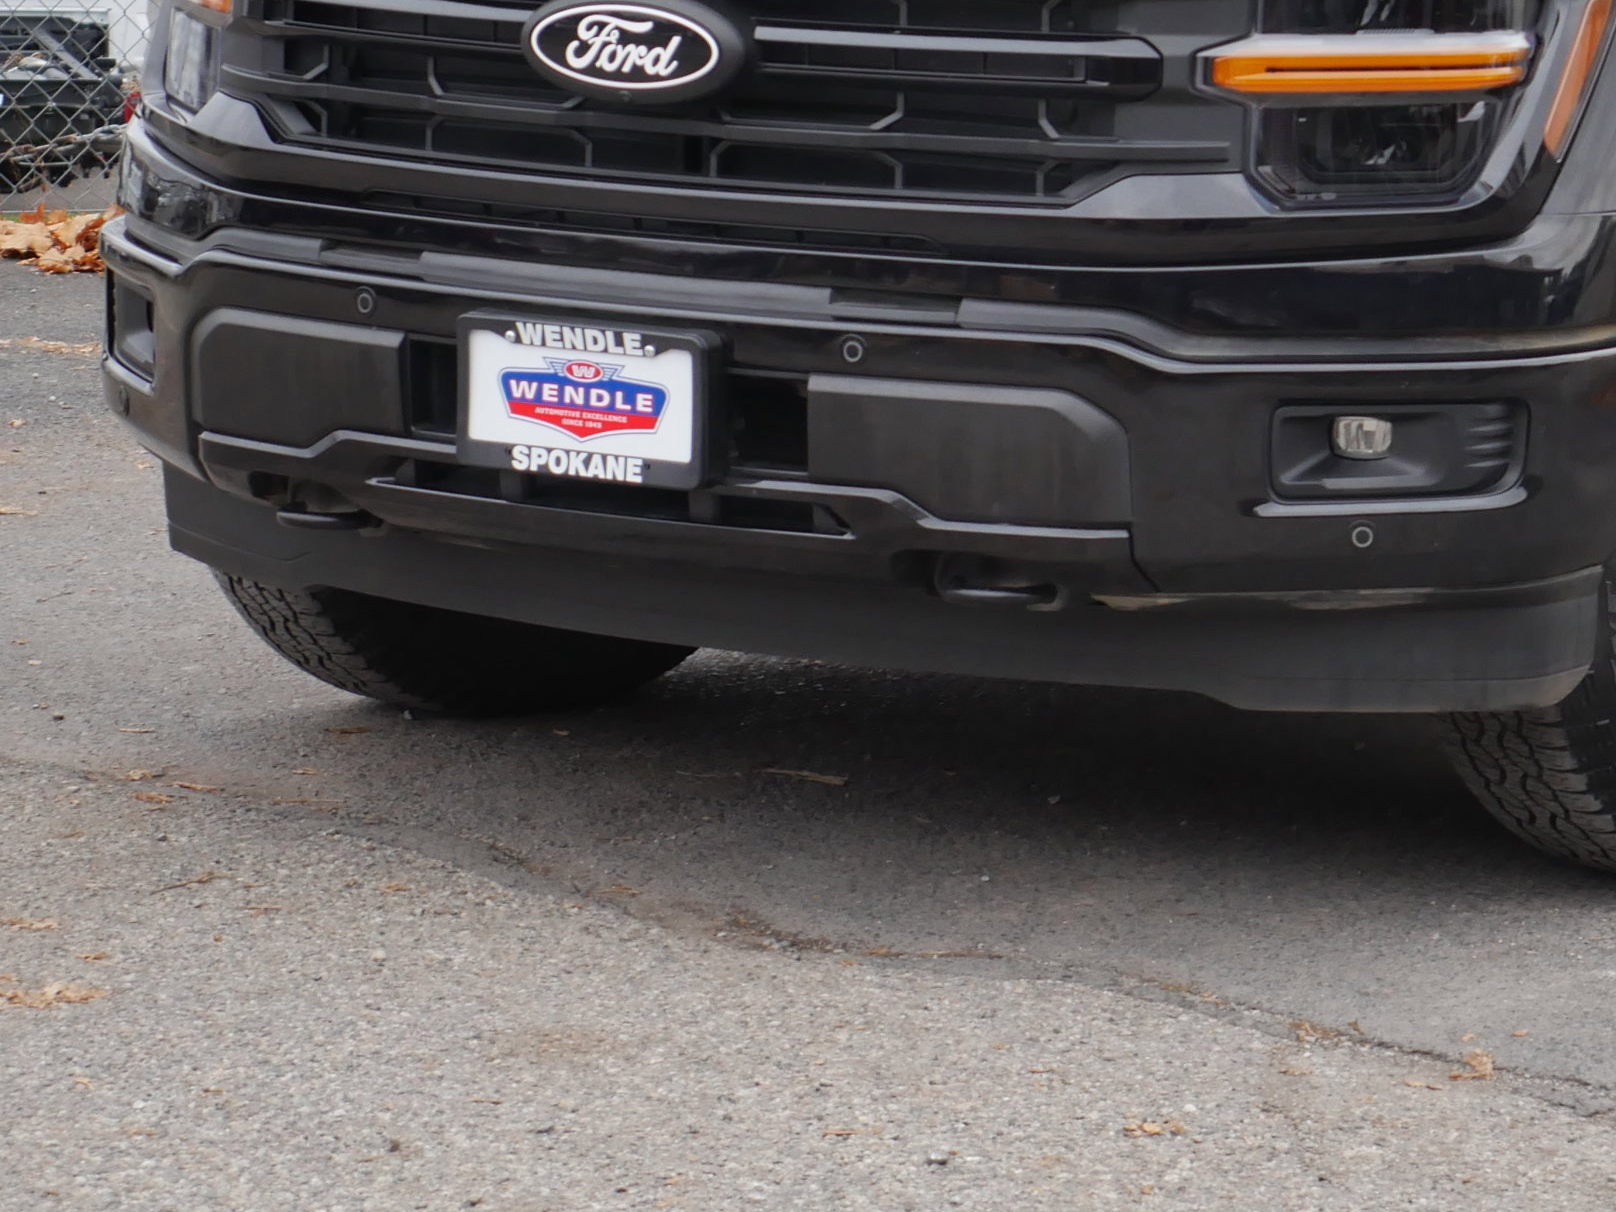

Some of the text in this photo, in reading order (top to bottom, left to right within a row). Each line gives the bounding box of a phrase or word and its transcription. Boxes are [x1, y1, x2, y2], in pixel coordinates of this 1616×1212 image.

[565, 14, 682, 77] Ford
[515, 321, 645, 357] WENDLE
[508, 379, 654, 413] WENDLE
[534, 406, 628, 423] AUTOMOTIVE EXCELLENCE
[561, 417, 583, 427] SINCE
[511, 444, 644, 483] SPOKANE
